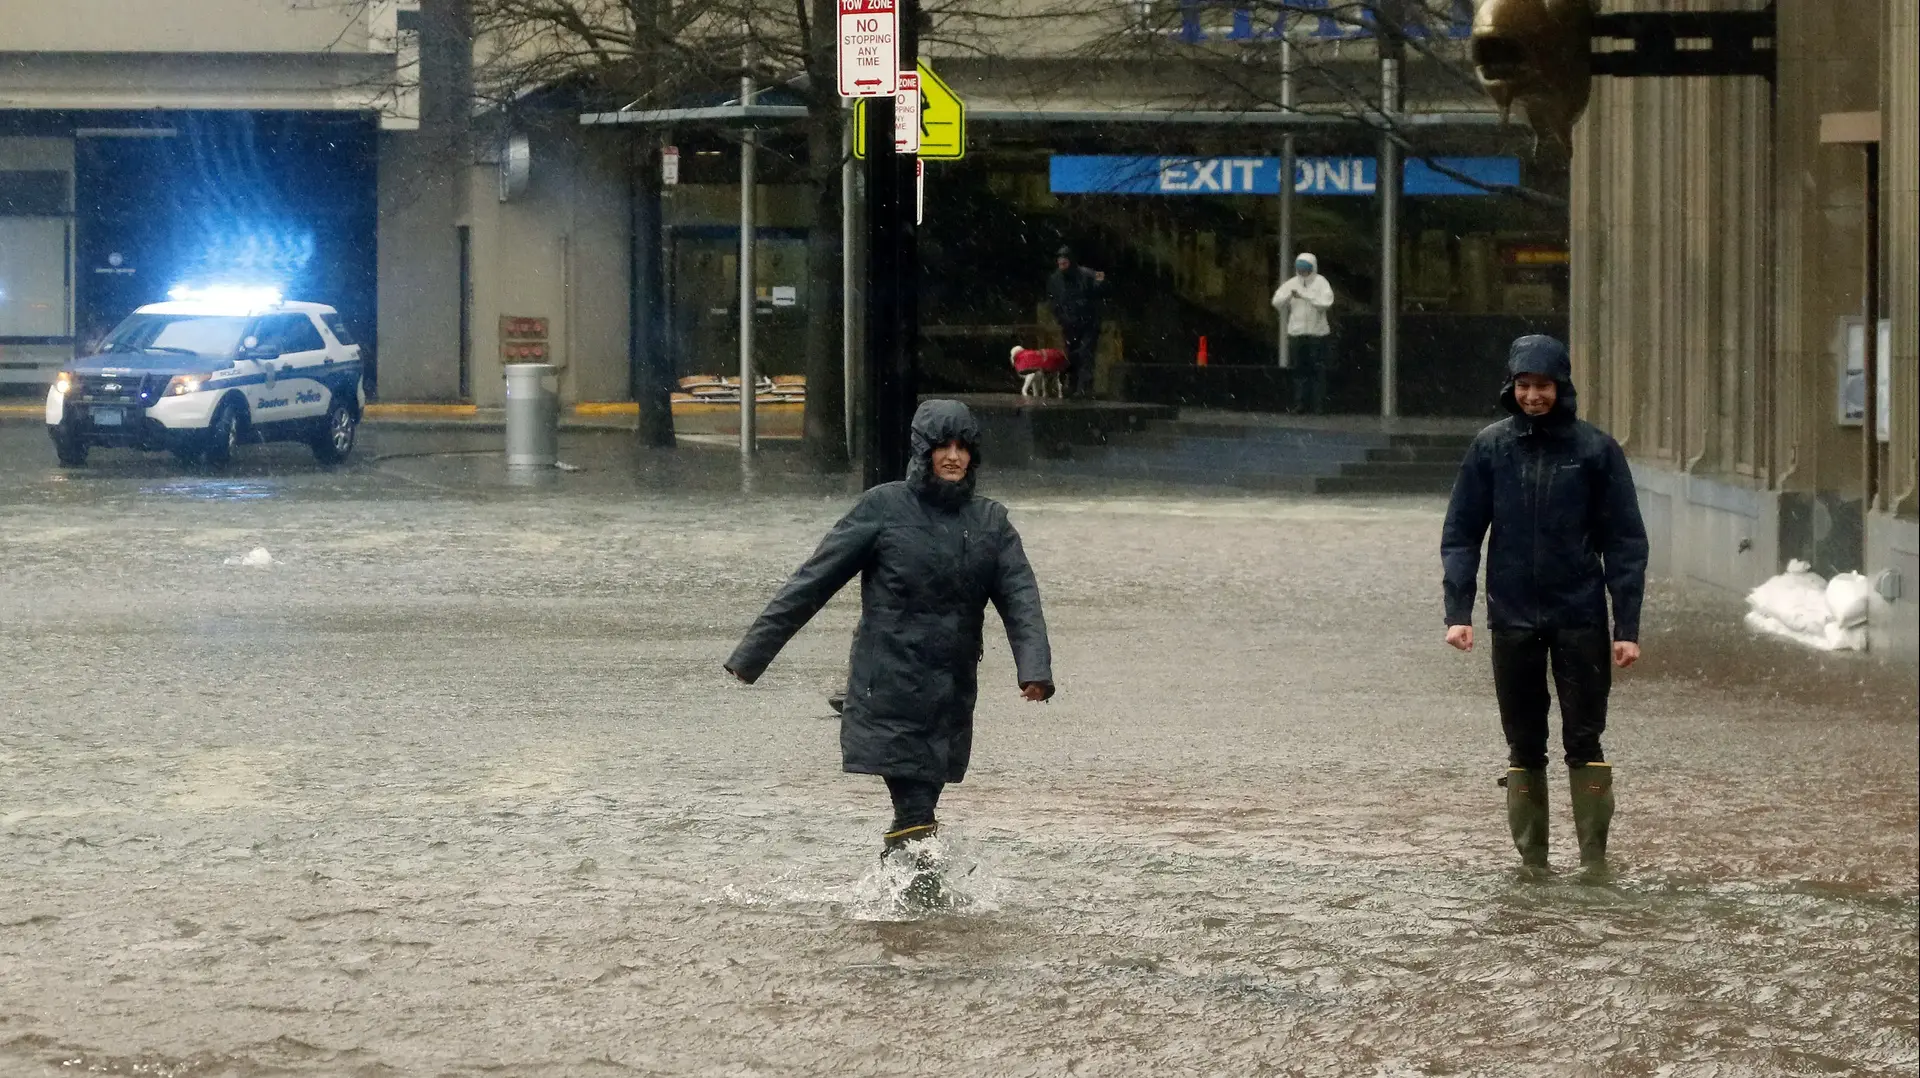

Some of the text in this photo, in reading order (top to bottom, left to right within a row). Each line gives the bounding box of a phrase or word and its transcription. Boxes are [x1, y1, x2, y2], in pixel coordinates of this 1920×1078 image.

[842, 0, 892, 10] TOW ZONE
[856, 19, 878, 32] NO
[844, 34, 891, 45] STOPPING
[858, 47, 878, 55] ANY
[856, 57, 880, 66] TIME
[895, 106, 915, 114] PPING
[1159, 158, 1376, 191] EXIT ONL
